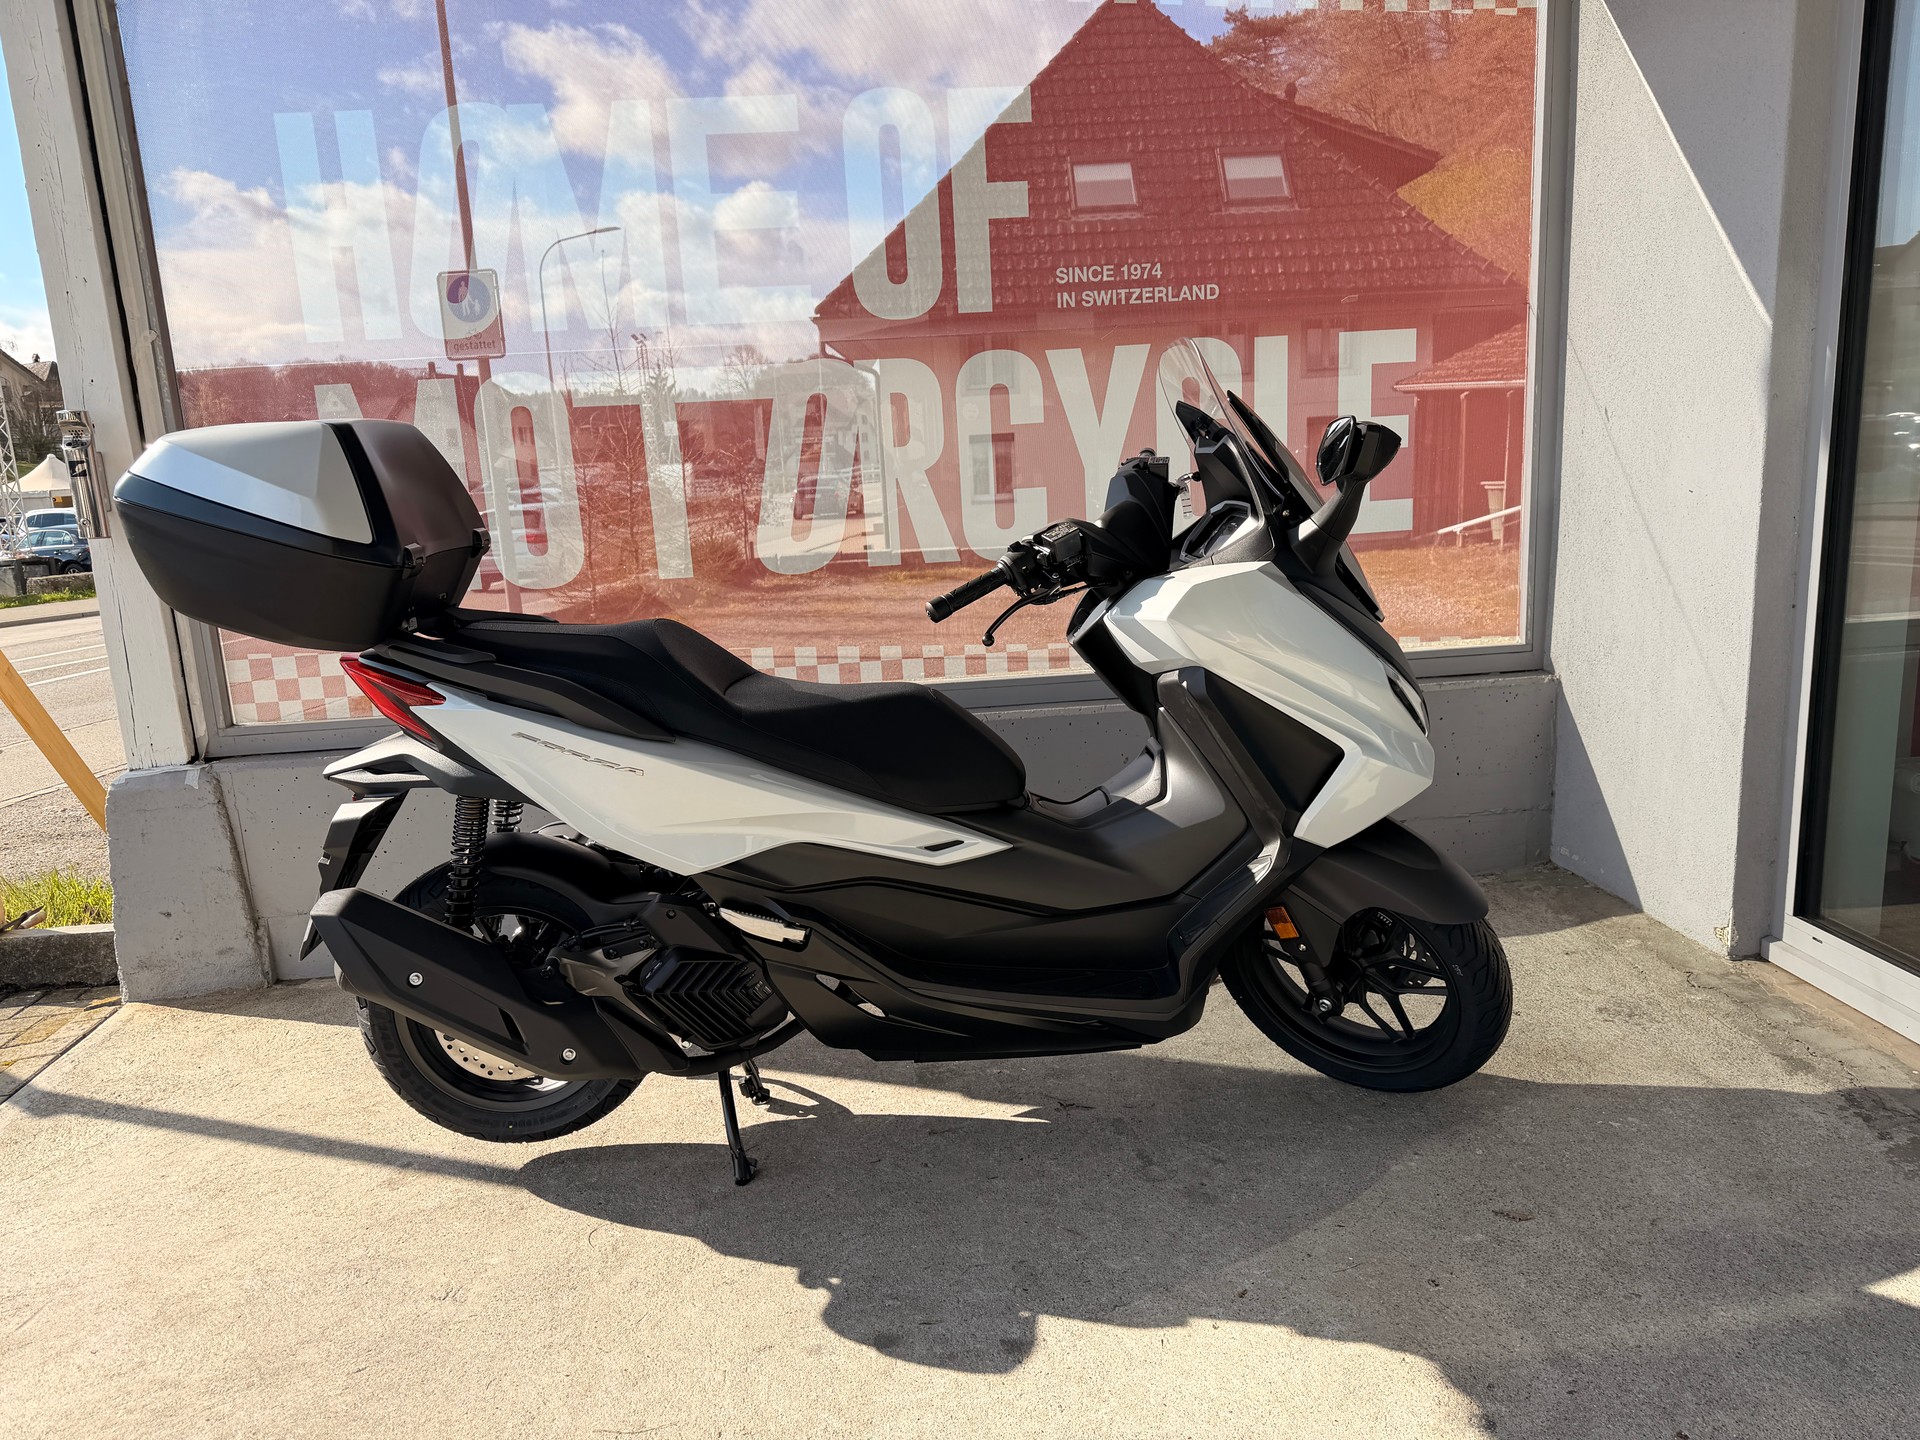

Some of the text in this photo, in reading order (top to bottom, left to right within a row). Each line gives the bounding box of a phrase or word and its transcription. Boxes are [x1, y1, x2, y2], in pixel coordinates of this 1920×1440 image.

[273, 85, 1032, 343] HOME OF
[1055, 262, 1163, 285] SINCE 1974
[1056, 283, 1220, 309] IN SWITZERLAND
[453, 340, 497, 353] gestattet
[511, 731, 645, 777] FORZA
